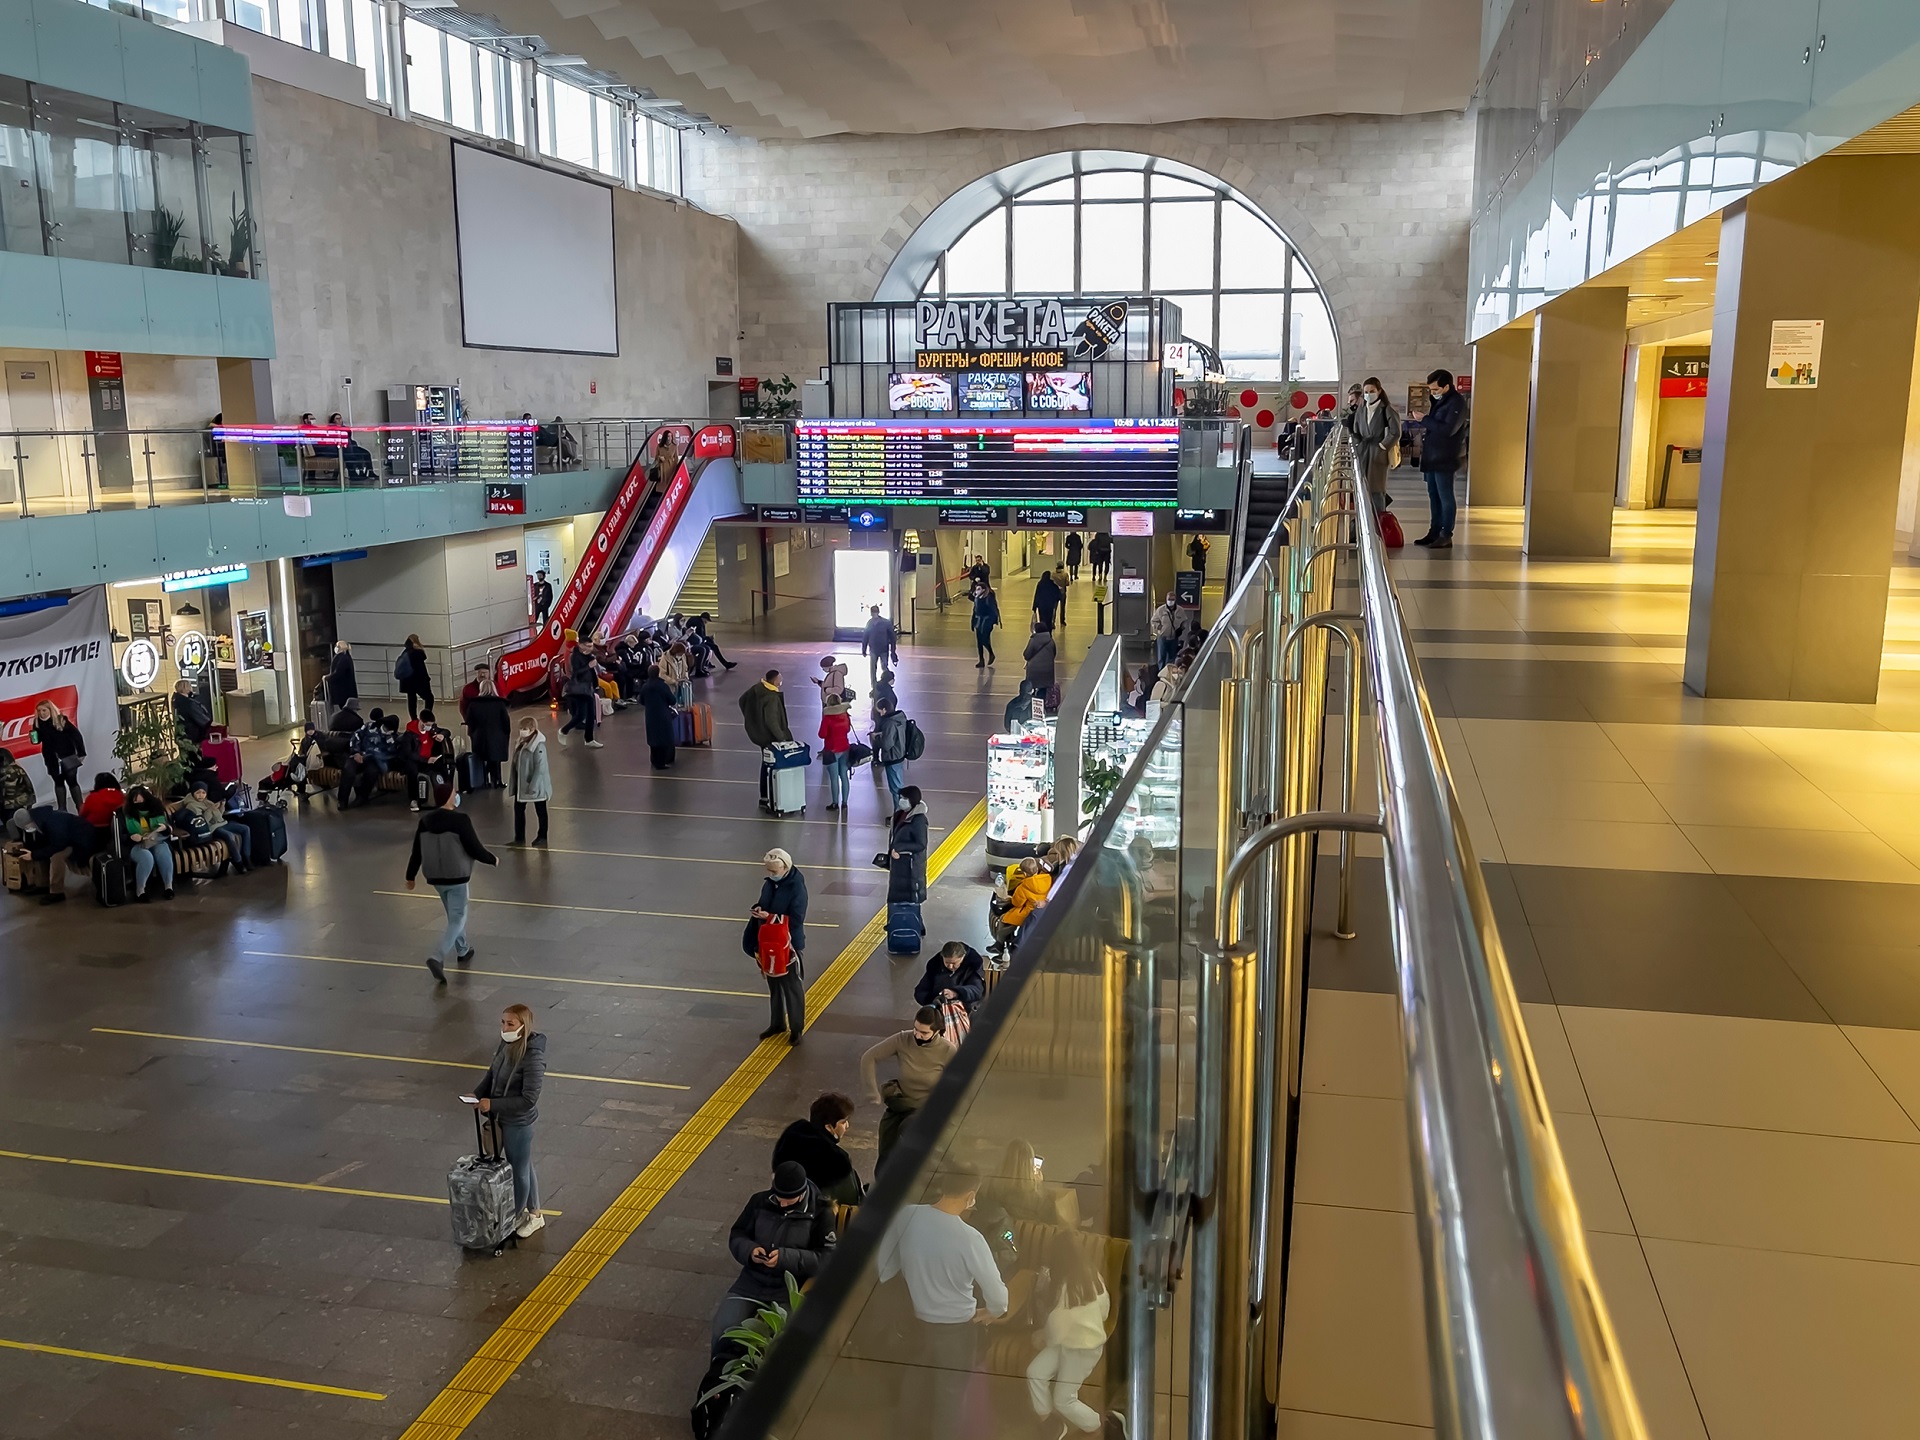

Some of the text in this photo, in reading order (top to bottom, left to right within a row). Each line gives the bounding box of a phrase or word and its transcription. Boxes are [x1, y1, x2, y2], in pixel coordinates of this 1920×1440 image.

[916, 301, 1067, 345] РАКЕТА
[1088, 308, 1120, 343] РАКЕТА
[918, 351, 1064, 368] БУРГЕРЫ ФРЕШИ КОФЕ
[1170, 346, 1183, 359] 24
[911, 396, 947, 408] ВОЗЬМИ
[1031, 394, 1071, 408] С СОБОЙ
[1138, 418, 1178, 426] 04.11.2021
[626, 475, 639, 503] KFC
[670, 477, 683, 504] KFC
[609, 507, 622, 532] ЭТАЖ
[581, 556, 596, 584] KFC
[563, 590, 578, 617] ЭТАЖ
[509, 662, 523, 676] KFC
[527, 657, 540, 669] ЭТАЖ
